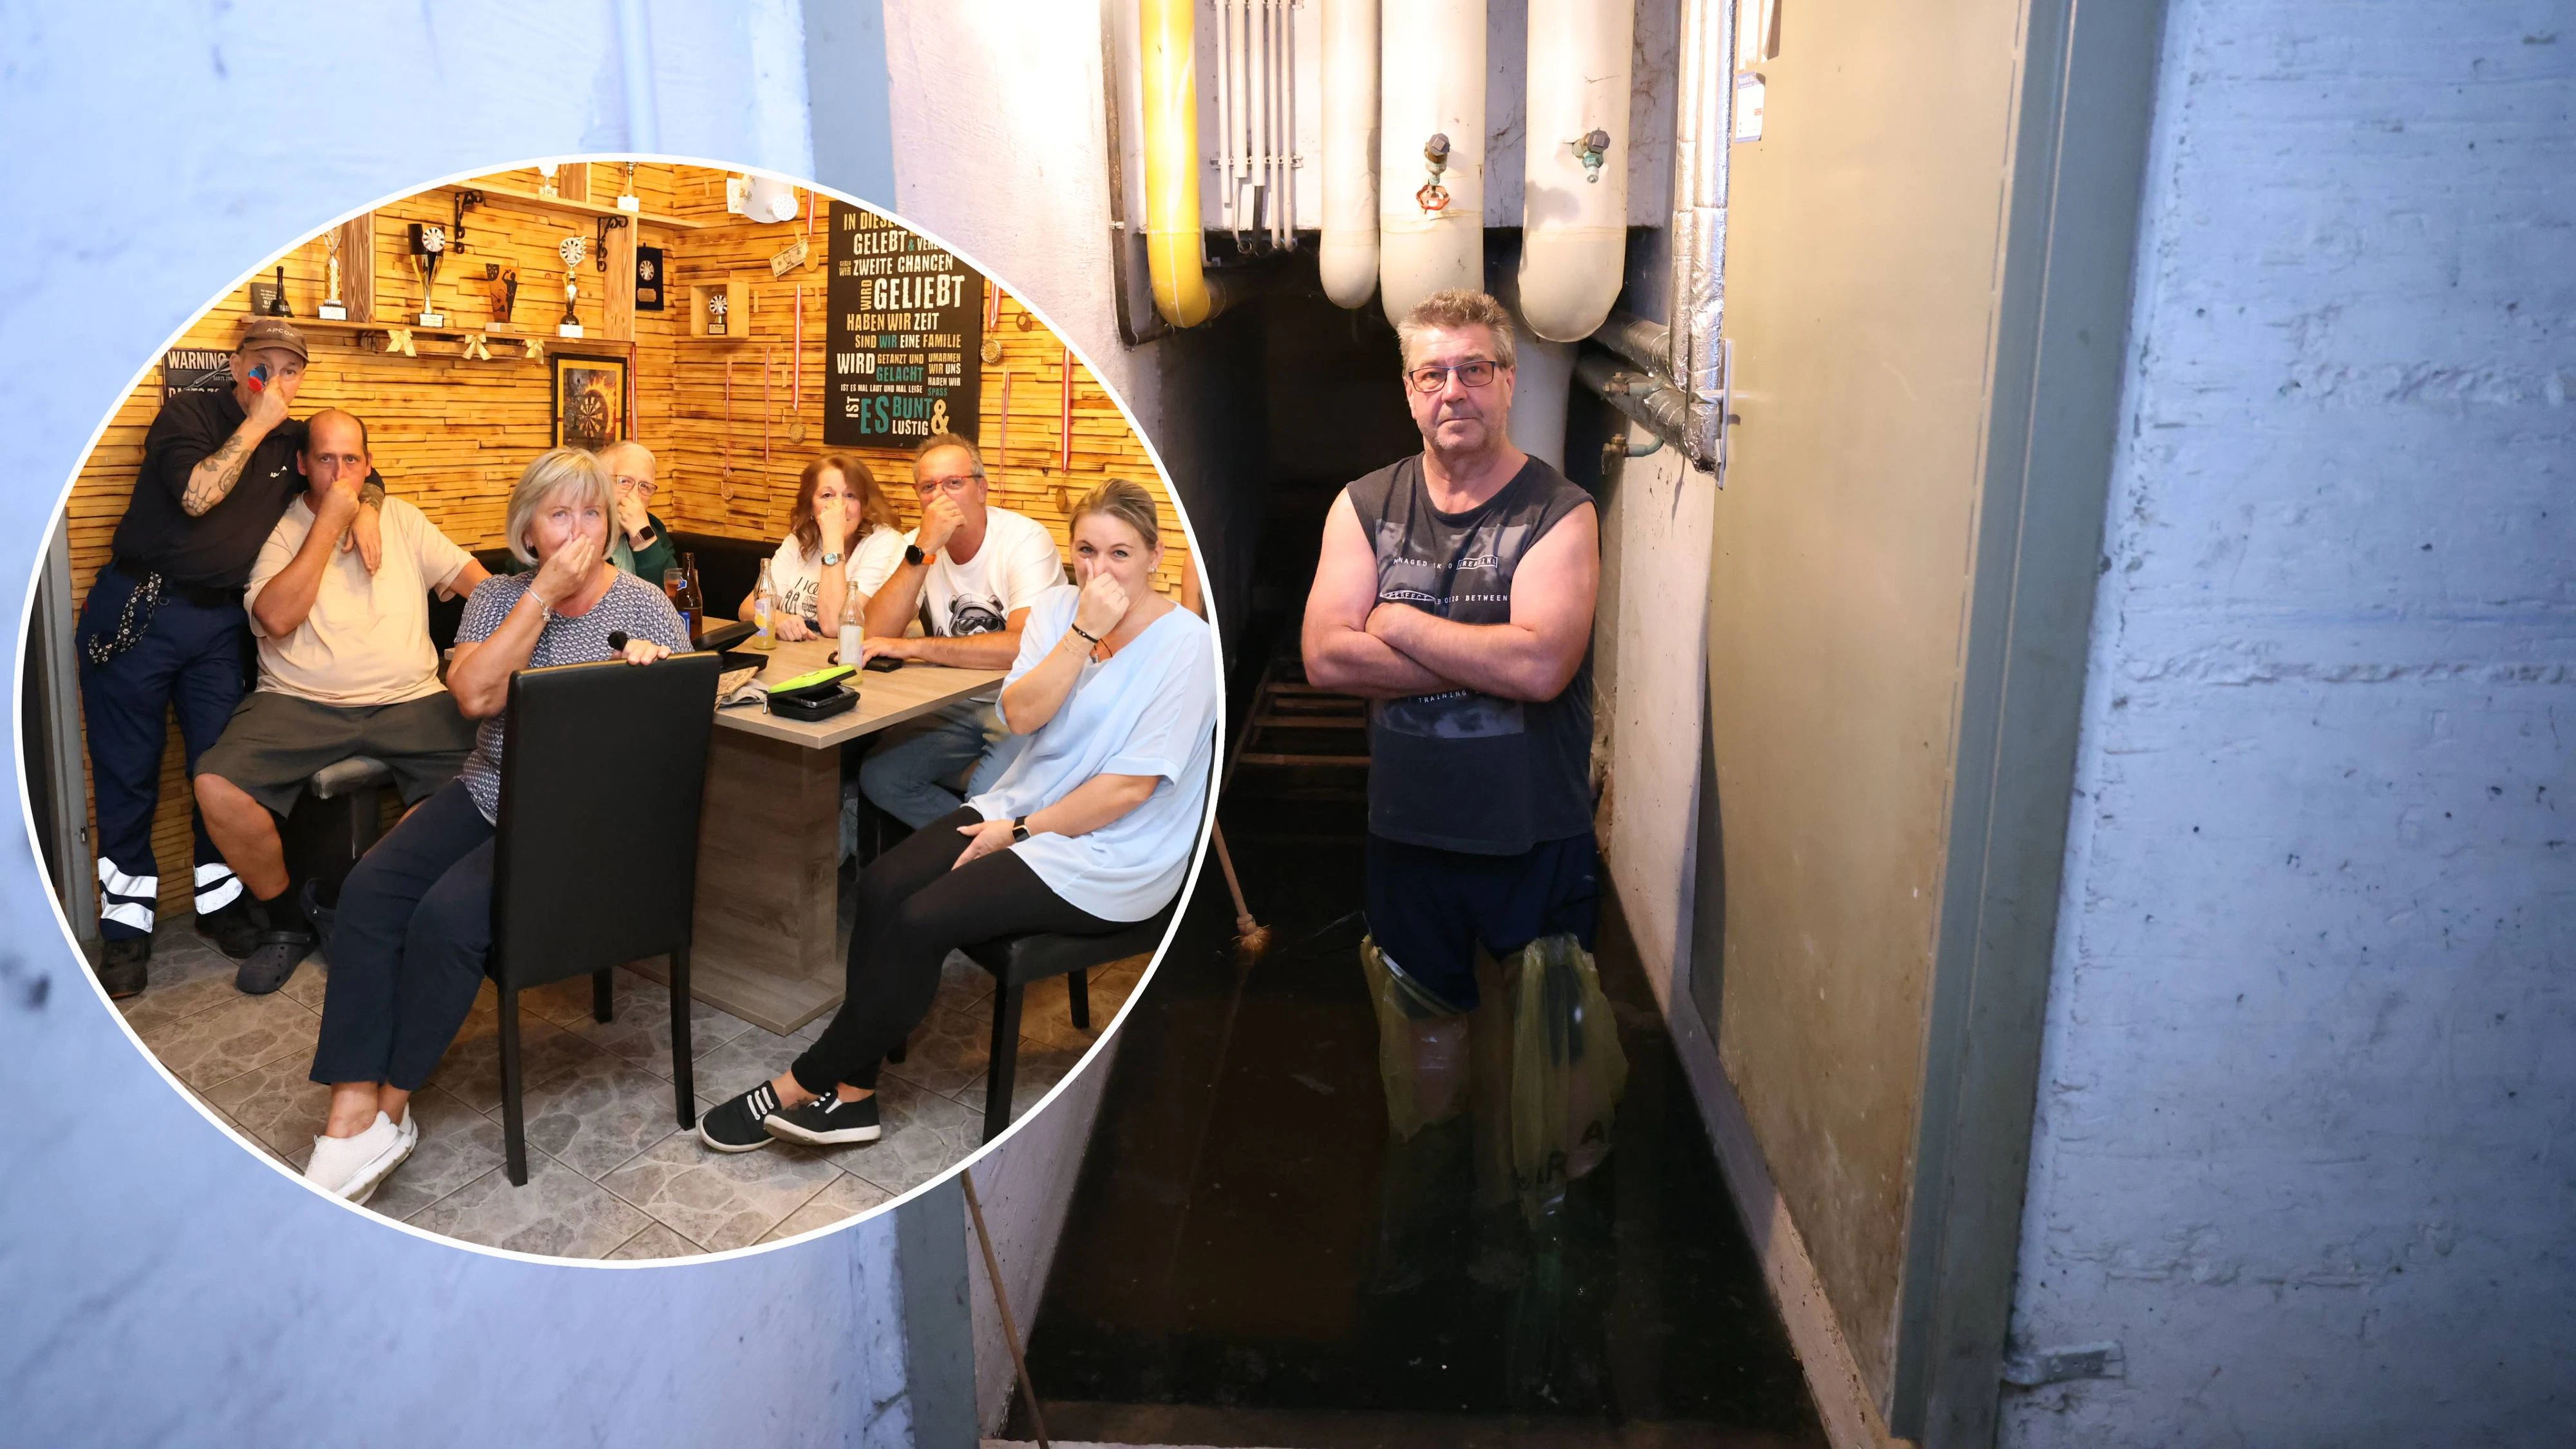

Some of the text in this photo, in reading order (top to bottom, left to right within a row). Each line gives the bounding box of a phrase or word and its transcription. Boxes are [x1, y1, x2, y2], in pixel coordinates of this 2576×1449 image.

[844, 213, 856, 231] IN
[853, 230, 907, 255] GELEBT
[908, 239, 914, 251] &
[839, 267, 851, 276] WIR
[853, 253, 953, 276] ZWEITE CHANCEN
[860, 279, 873, 310] WIRD
[874, 274, 965, 310] GELIEBT
[847, 312, 939, 331] HABEN WIR ZEIT
[855, 334, 961, 348] SIND WIR EINE FAMILIE
[837, 353, 875, 374] WIRD
[877, 354, 923, 365] GETANZT UND
[928, 353, 961, 363] UMARMEN
[876, 366, 923, 382] GELACHT
[929, 363, 961, 374] WIR UNS
[840, 384, 922, 393] IST ES MAL LAUT UND MAL LEISE
[927, 377, 961, 386] HABEN WIR
[927, 388, 948, 397] SPASS
[846, 396, 860, 418] IST
[860, 395, 889, 434] ES
[893, 395, 949, 435] BUNT &
[892, 420, 928, 436] LUSTIG
[1418, 690, 1467, 703] TRAINING
